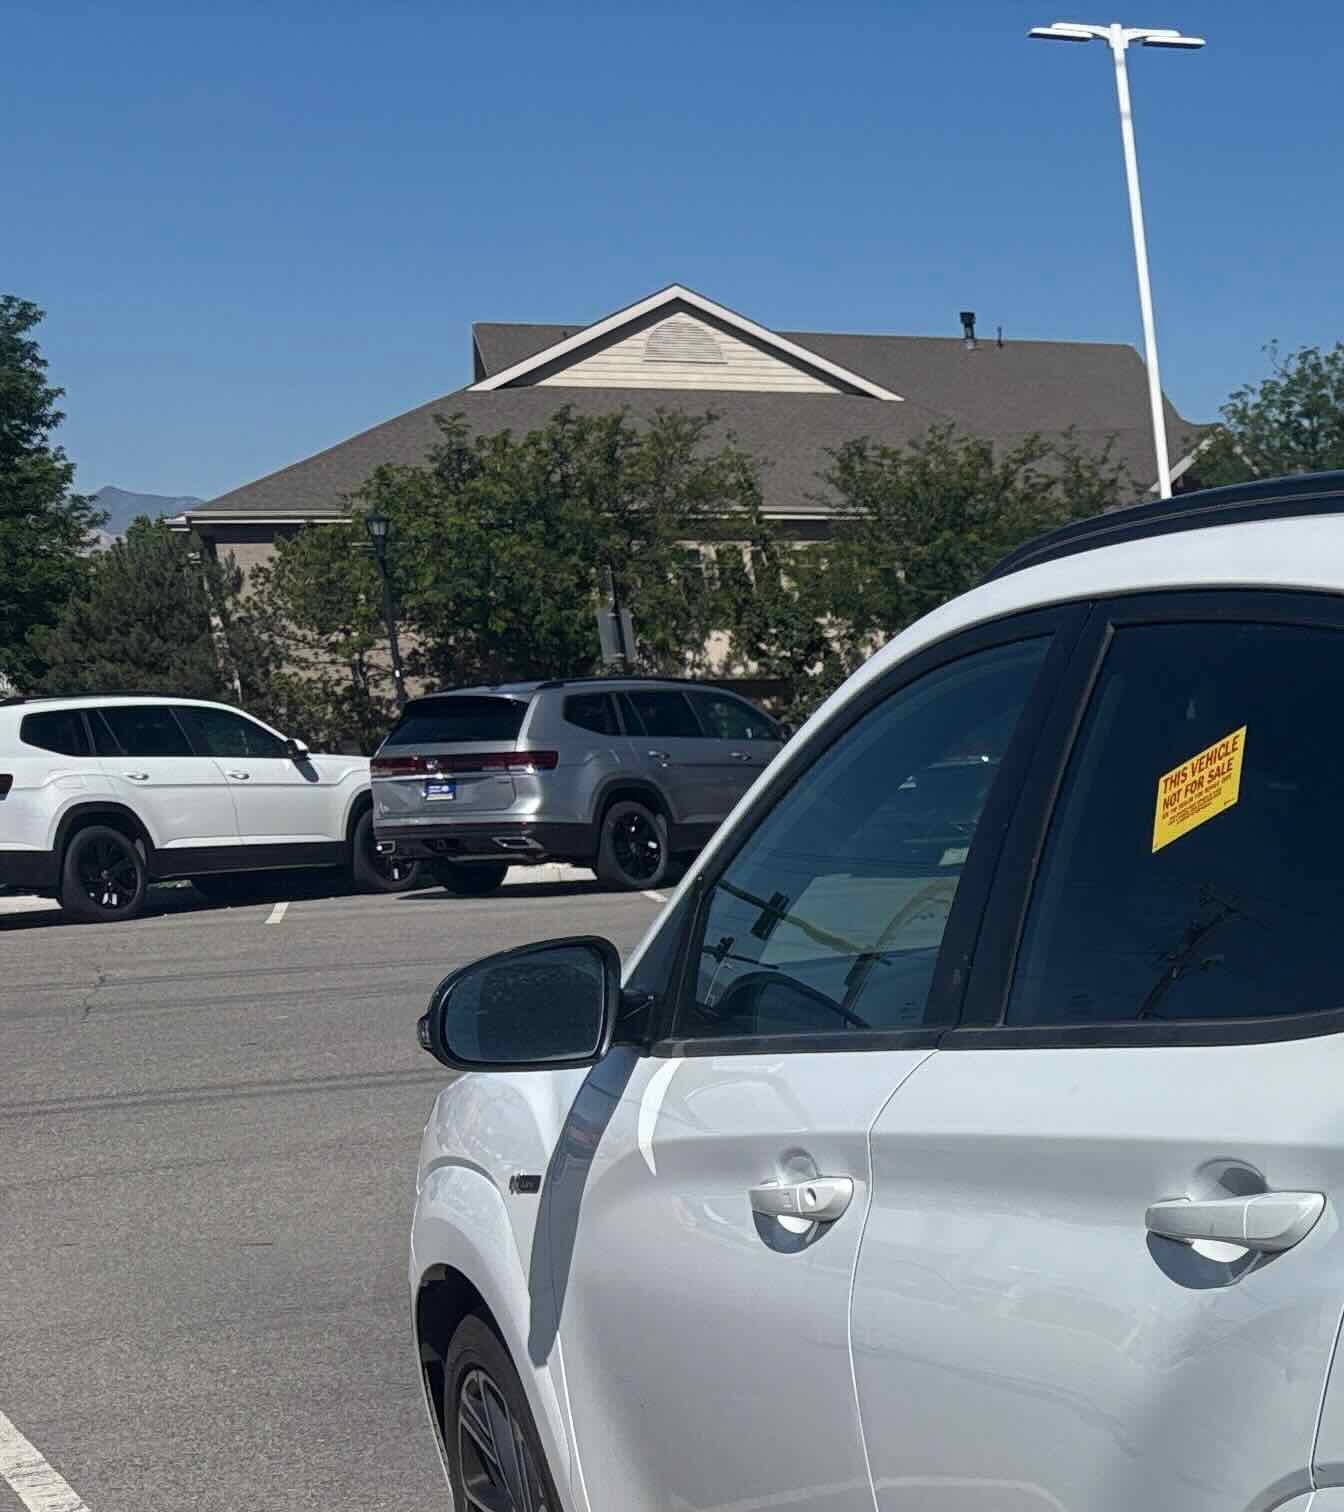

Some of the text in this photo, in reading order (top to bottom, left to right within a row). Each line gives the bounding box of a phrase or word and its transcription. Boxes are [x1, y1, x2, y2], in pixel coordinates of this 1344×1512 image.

[1161, 788, 1183, 810] NOT
[1184, 776, 1204, 798] FOR
[1207, 757, 1234, 783] SALE
[1162, 735, 1241, 794] THIS VEHICLE
